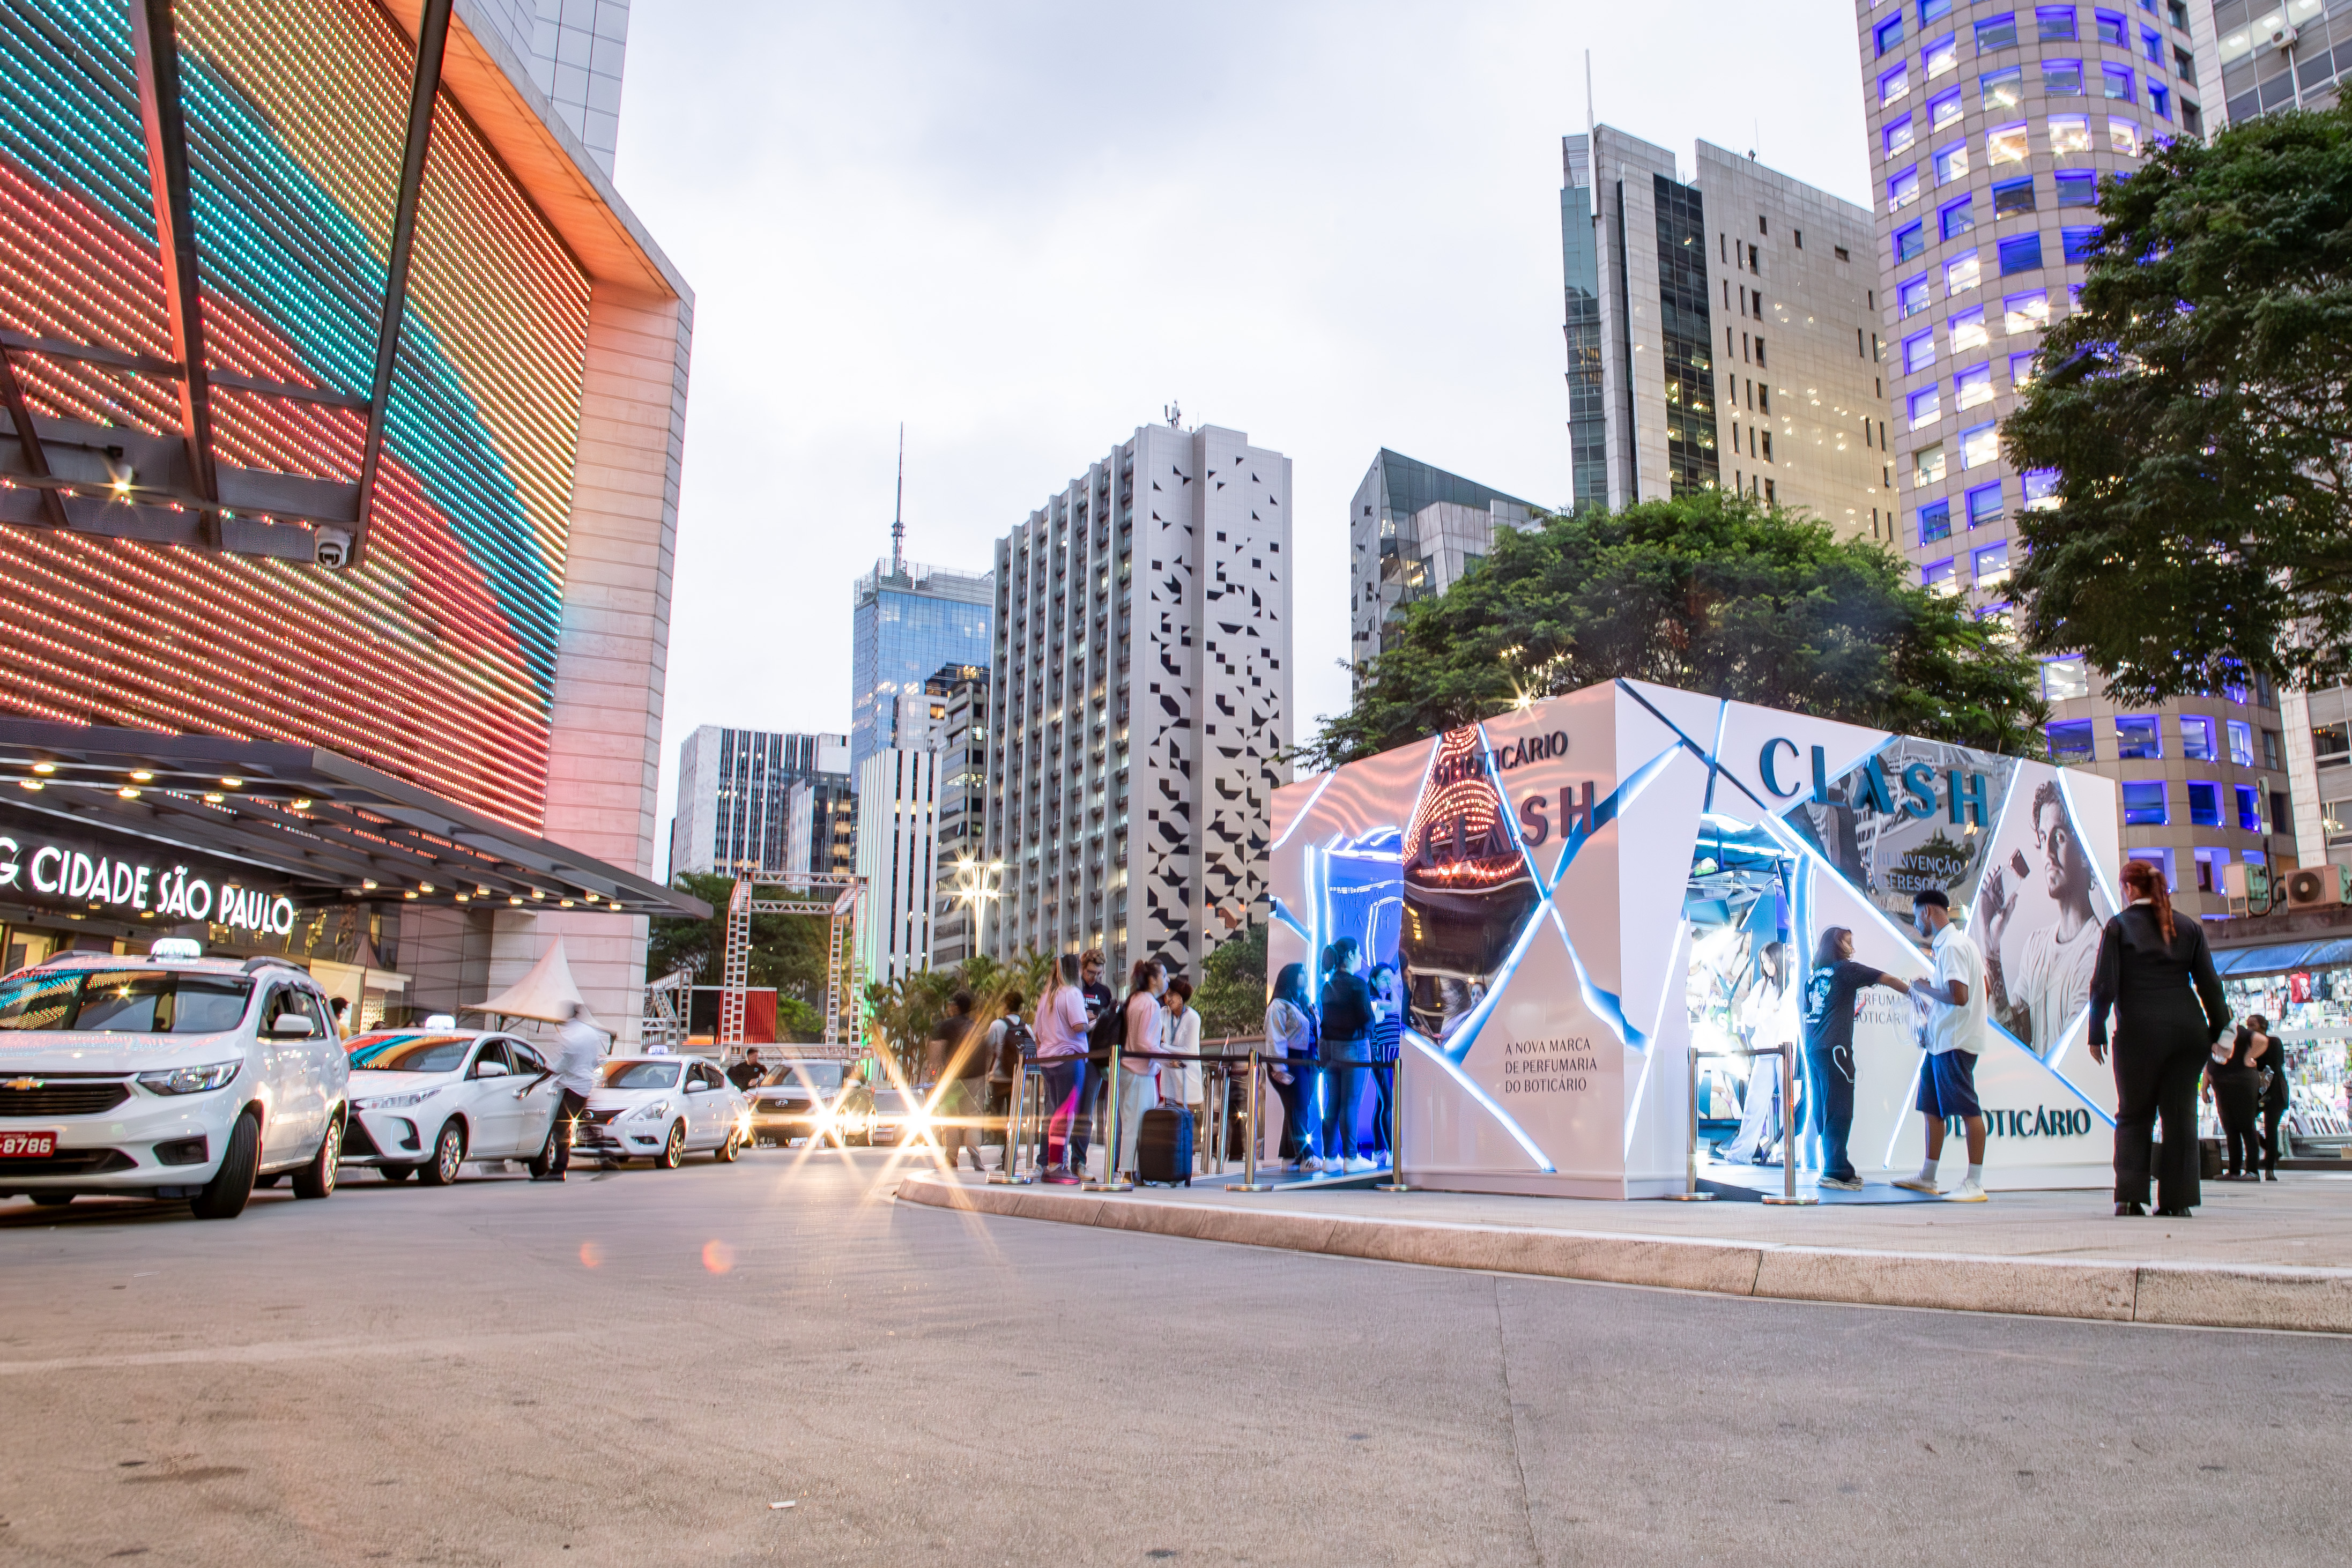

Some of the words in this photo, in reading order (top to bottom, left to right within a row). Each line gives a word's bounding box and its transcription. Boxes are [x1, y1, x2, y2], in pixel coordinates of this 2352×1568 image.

[1759, 737, 1989, 827] CLASH
[31, 846, 151, 909] CIDADE
[157, 865, 212, 920] SÃO
[218, 884, 293, 935] PAULO
[1505, 1043, 1512, 1056] A
[1516, 1040, 1546, 1054] NOVA
[1549, 1037, 1591, 1053] MARCA
[1505, 1061, 1518, 1074] DE
[1523, 1057, 1597, 1074] PERFUMARIA
[1505, 1079, 1520, 1094] DO
[1524, 1073, 1587, 1093] BOTICÁRIO
